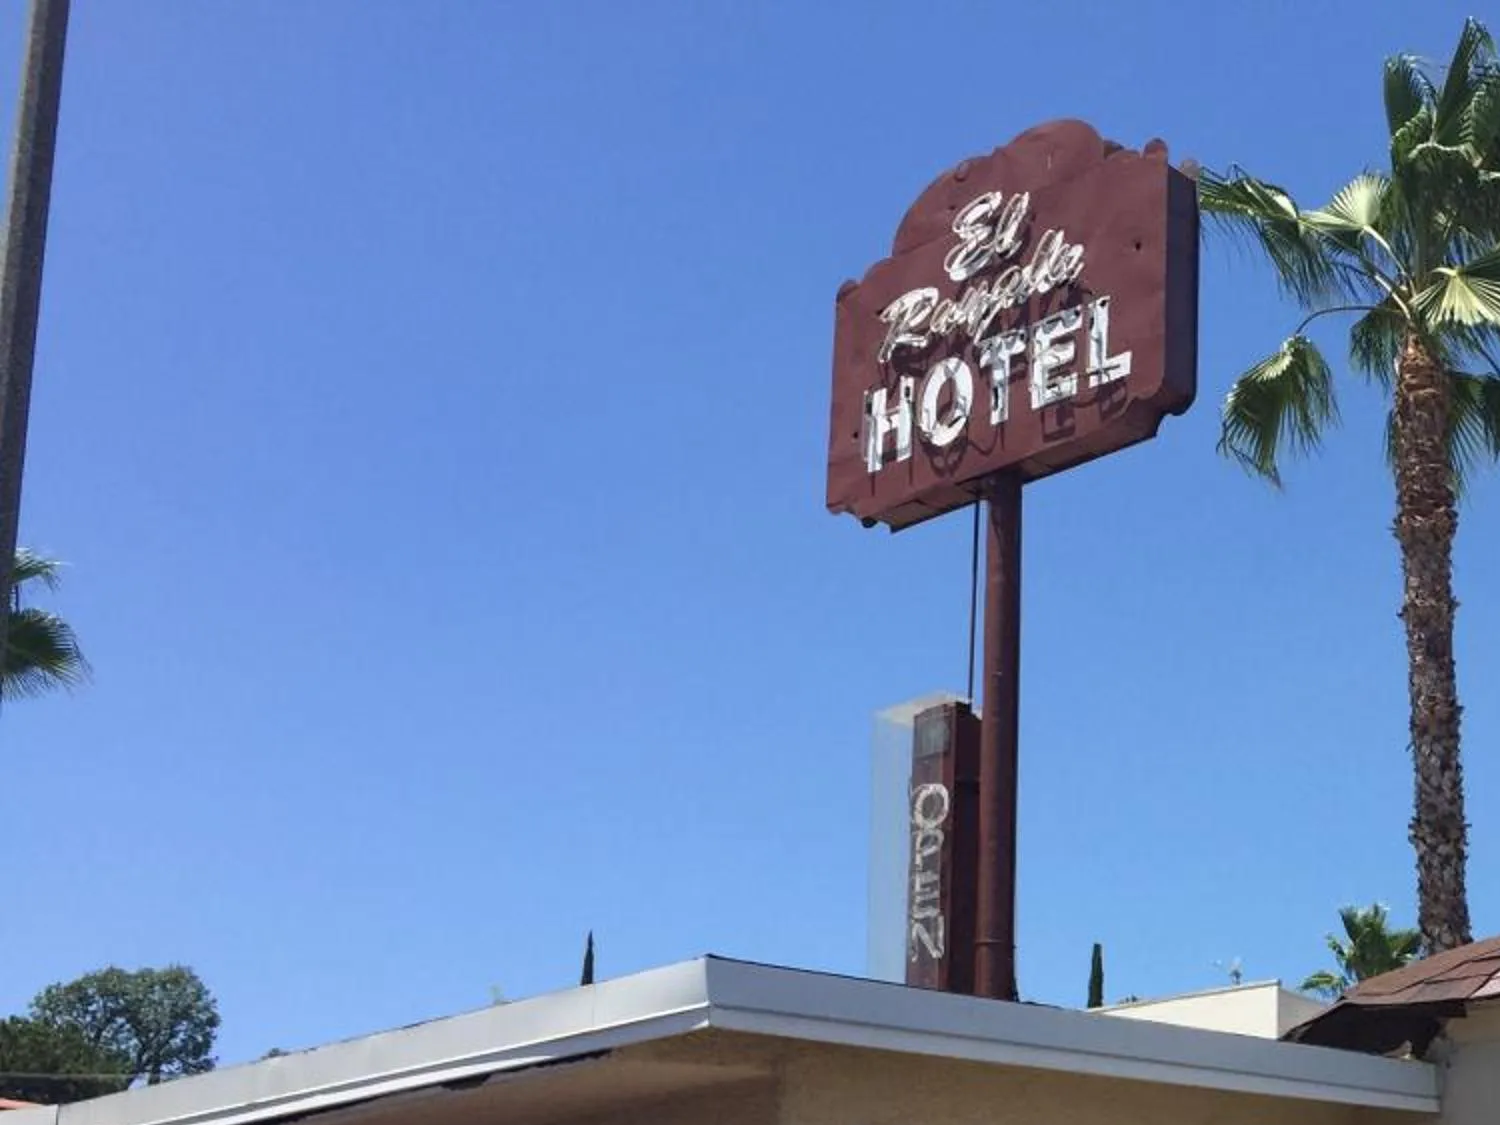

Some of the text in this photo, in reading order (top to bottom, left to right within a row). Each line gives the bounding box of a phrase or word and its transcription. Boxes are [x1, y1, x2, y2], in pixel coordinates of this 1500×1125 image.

[944, 191, 1030, 281] El
[864, 296, 1132, 473] HOTEL
[910, 783, 950, 963] OPEN
